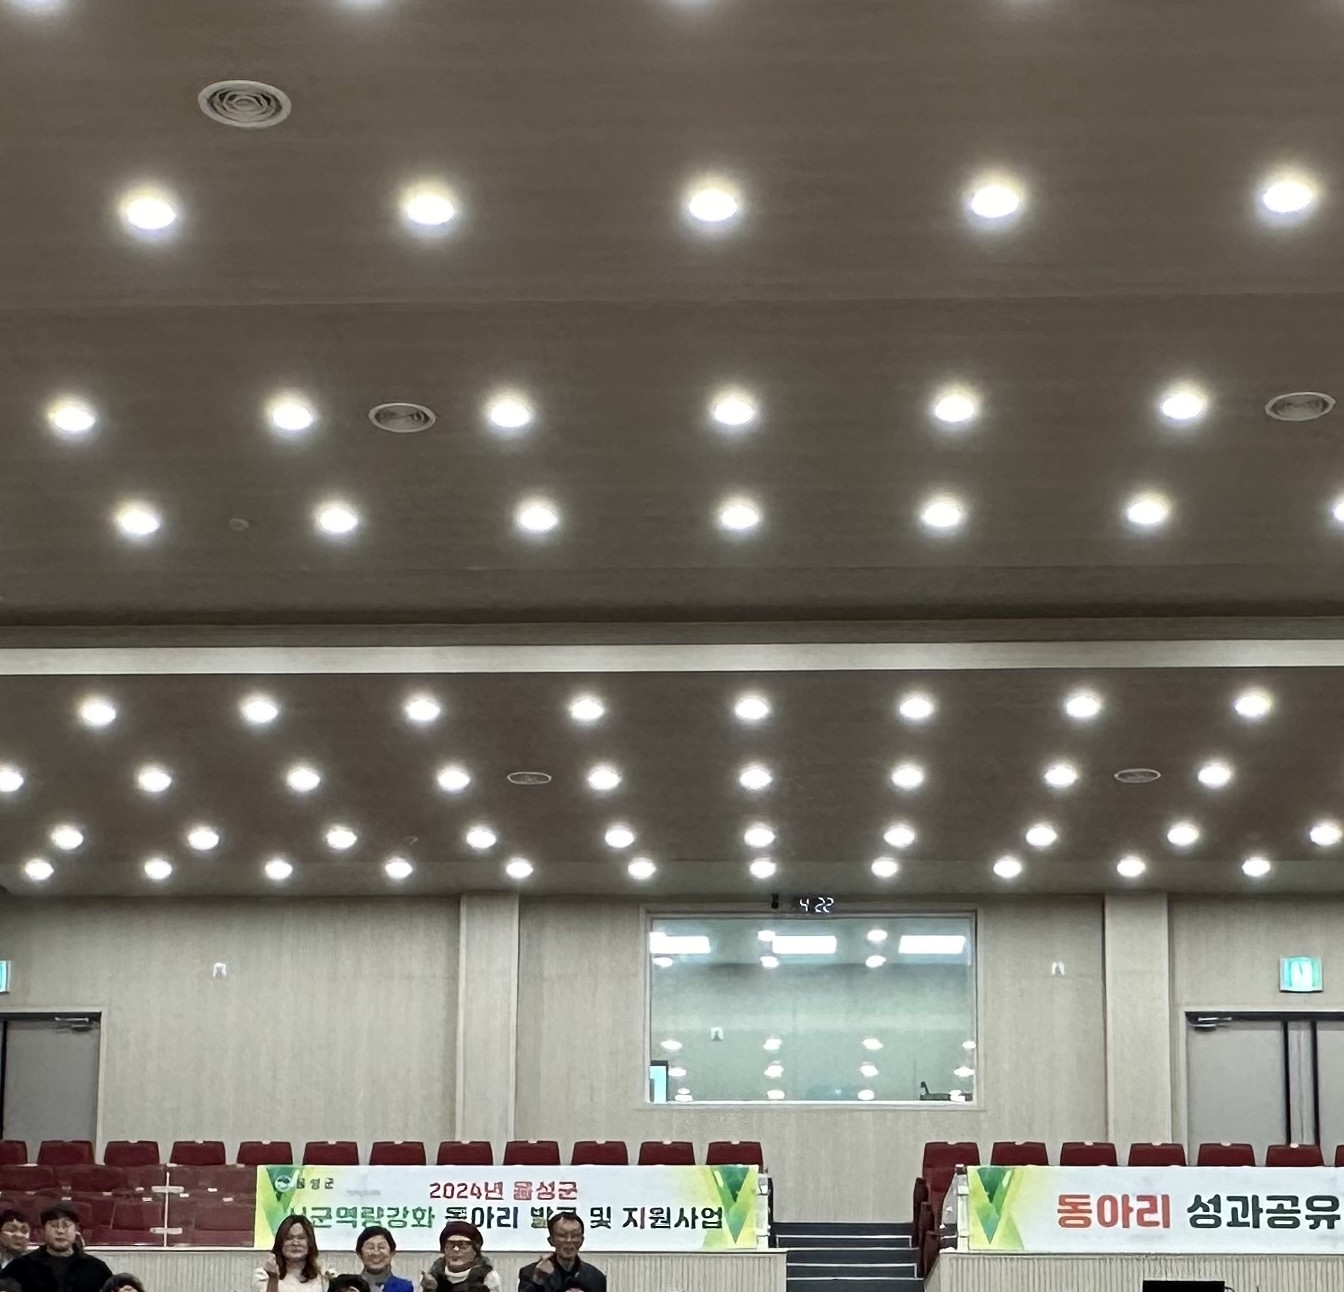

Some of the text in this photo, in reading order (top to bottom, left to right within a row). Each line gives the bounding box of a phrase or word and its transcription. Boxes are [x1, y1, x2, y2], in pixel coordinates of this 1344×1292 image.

[429, 1181, 504, 1201] 2024년
[530, 1206, 577, 1229] 발
[590, 1206, 612, 1229] 및
[622, 1206, 723, 1229] 지원사업
[1056, 1194, 1171, 1229] 동아리
